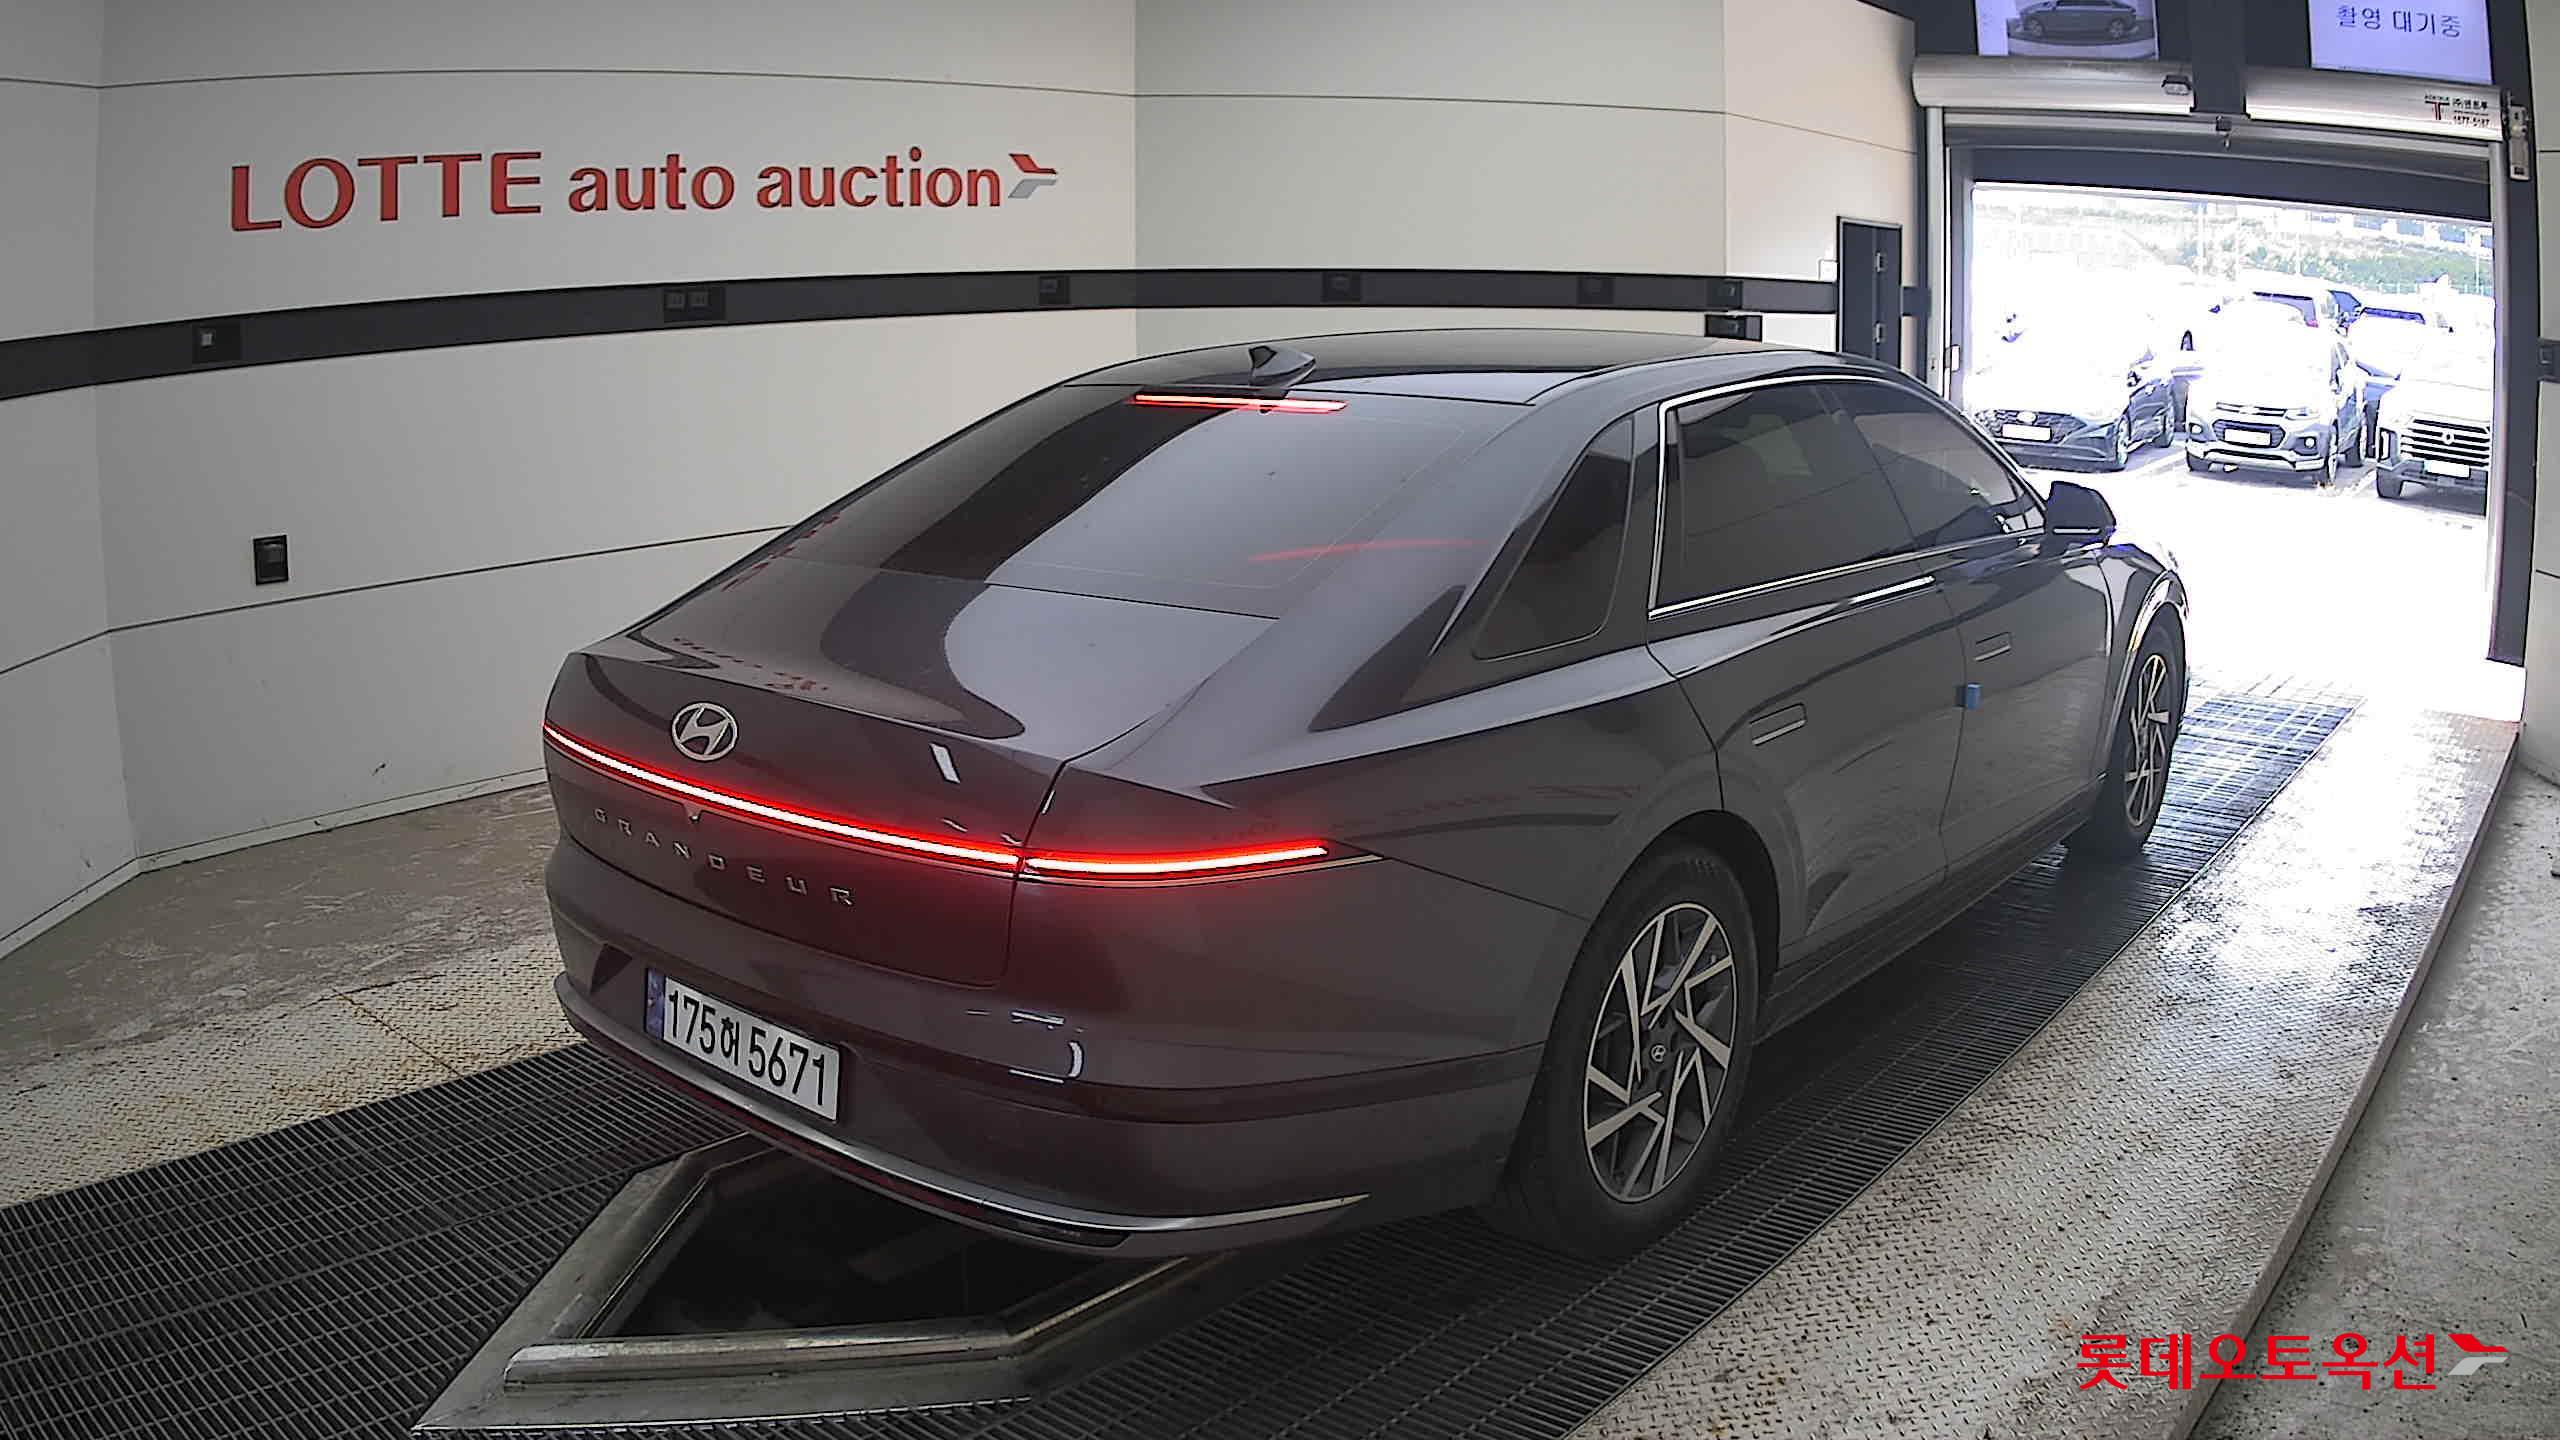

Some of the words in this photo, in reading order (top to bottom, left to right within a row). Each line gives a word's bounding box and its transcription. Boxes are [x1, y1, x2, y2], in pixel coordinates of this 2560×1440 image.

[2391, 10, 2461, 38] 대기중
[231, 151, 542, 232] LOTTE
[568, 153, 735, 212] auto
[756, 146, 1002, 209] auction
[594, 809, 856, 906] GRANDEUR
[668, 989, 741, 1067] 175허
[748, 1030, 826, 1107] 5671
